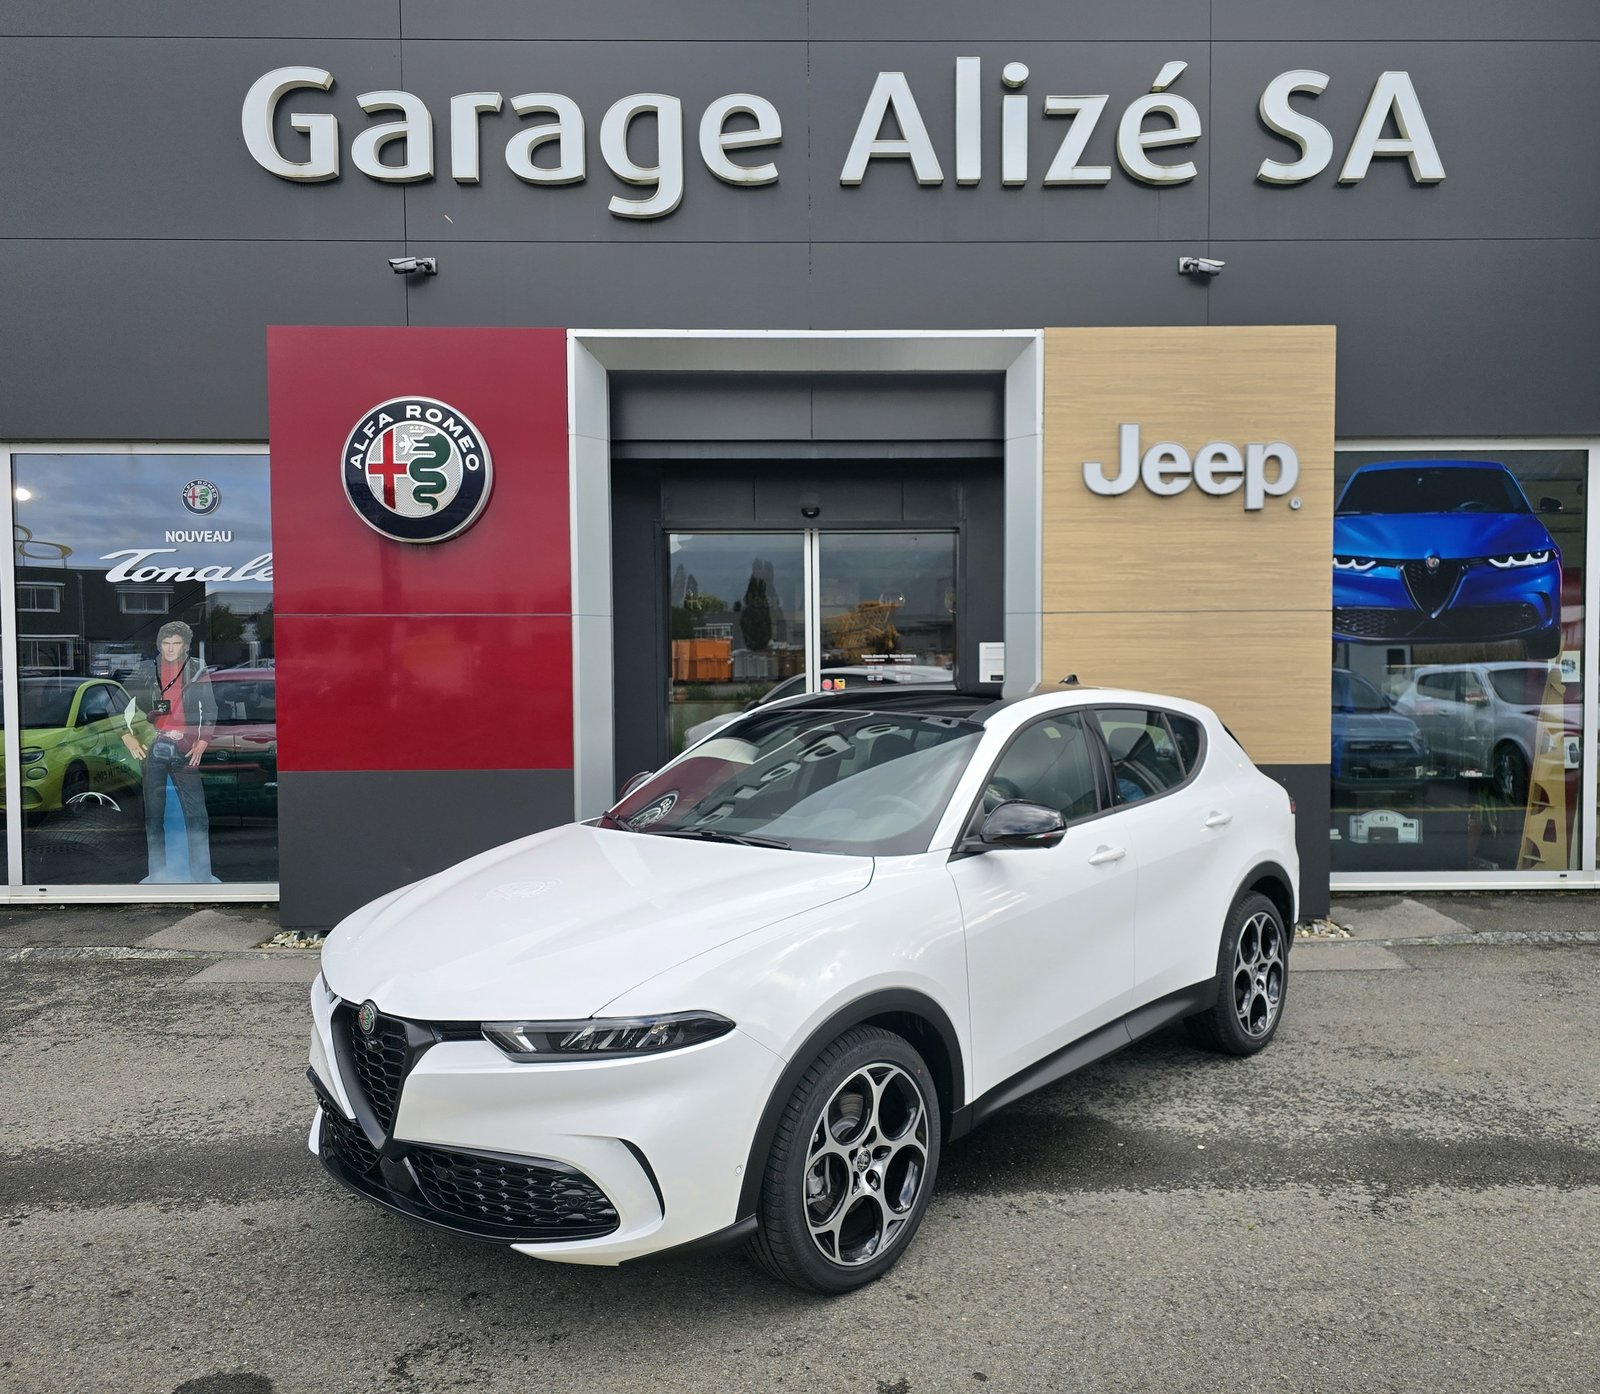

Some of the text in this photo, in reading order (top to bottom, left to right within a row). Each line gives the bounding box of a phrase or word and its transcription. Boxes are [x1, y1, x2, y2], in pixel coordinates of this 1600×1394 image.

[242, 56, 1448, 220] Garage Alizé SA
[350, 405, 480, 472] ALFA ROMEO
[1082, 422, 1300, 511] Jeep
[165, 530, 232, 543] NOUVEAU
